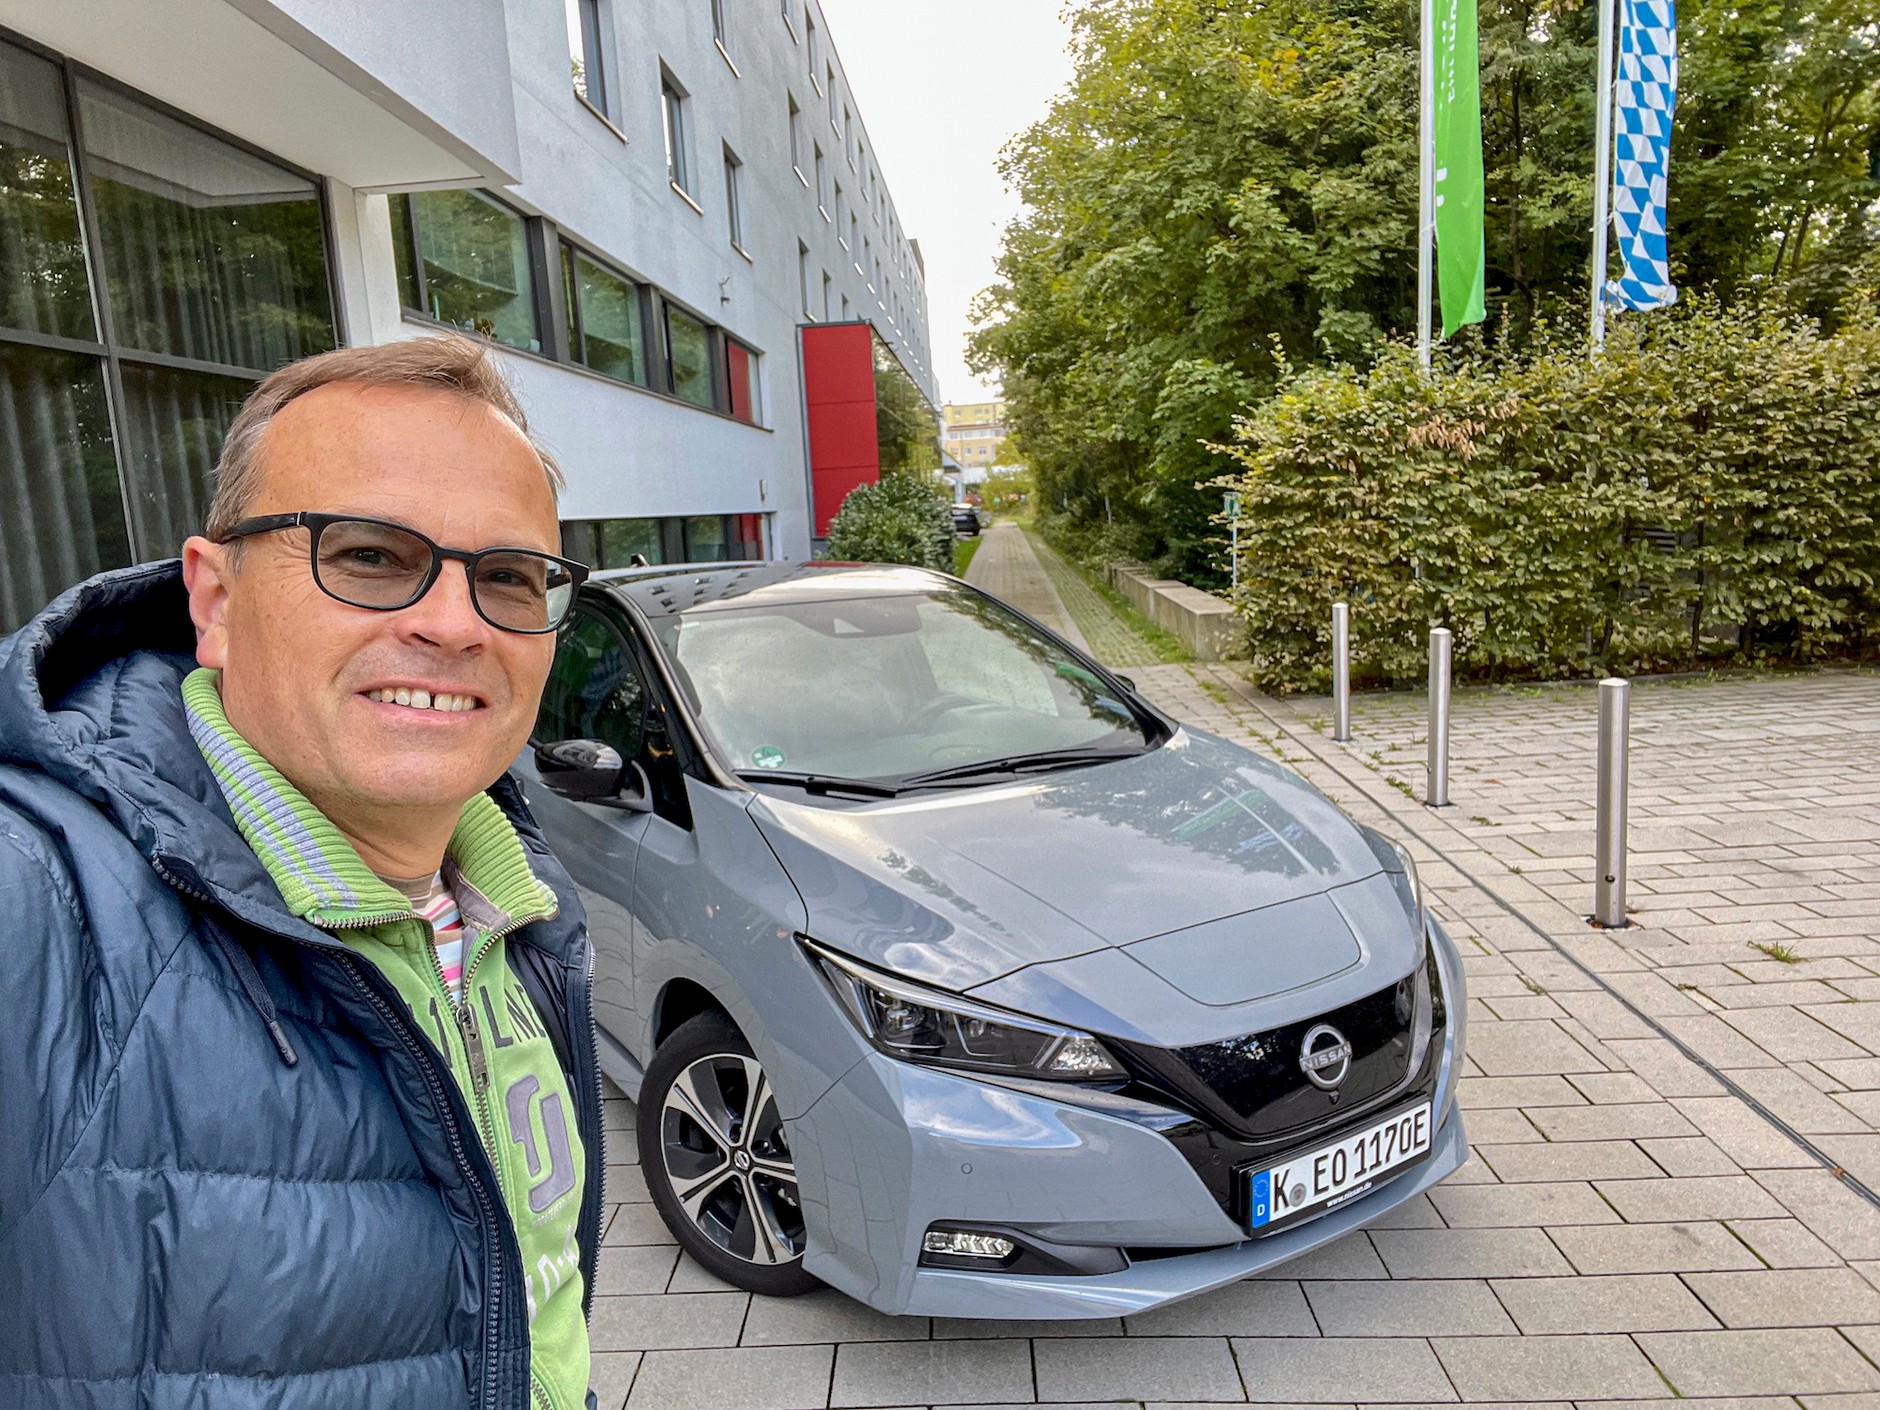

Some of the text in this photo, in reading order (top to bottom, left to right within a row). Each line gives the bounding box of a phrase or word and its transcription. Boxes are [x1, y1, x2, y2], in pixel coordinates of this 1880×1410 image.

[1302, 1044, 1352, 1072] NISSAN
[1273, 1168, 1291, 1213] K
[1354, 1109, 1428, 1179] 1170E
[1257, 1204, 1266, 1217] D
